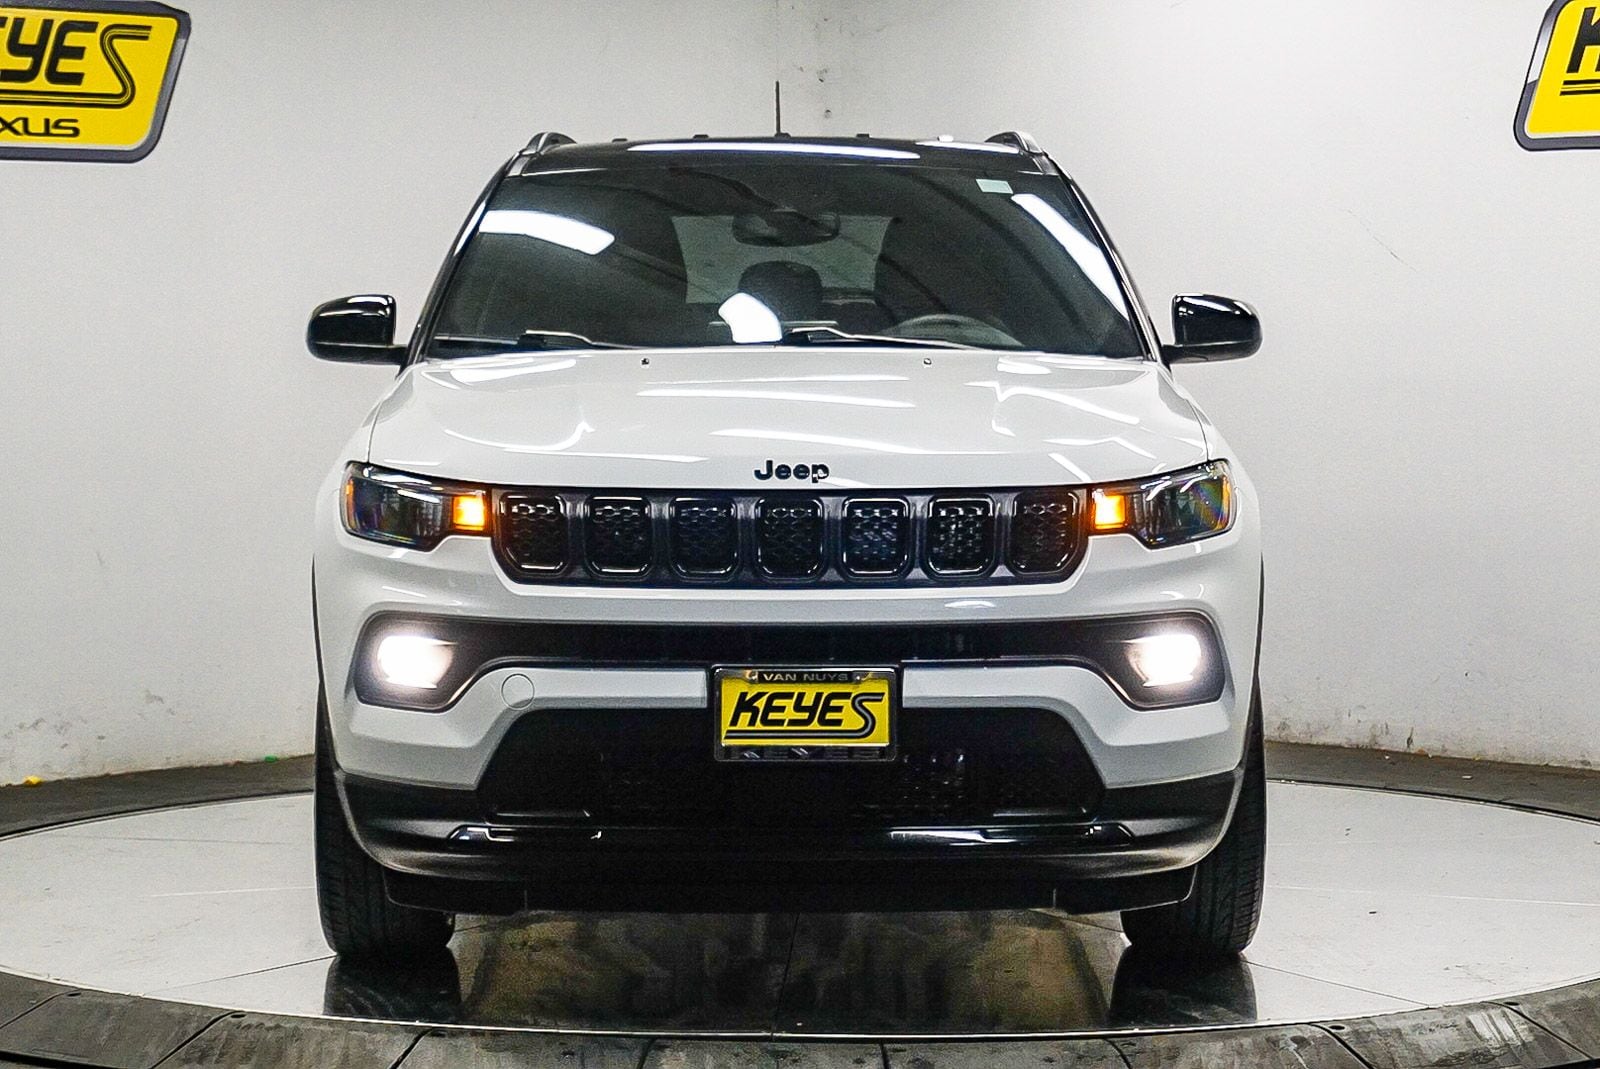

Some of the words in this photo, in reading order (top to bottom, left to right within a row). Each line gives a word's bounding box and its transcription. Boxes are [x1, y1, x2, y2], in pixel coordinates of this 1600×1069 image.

[0, 16, 153, 109] YES
[754, 459, 830, 484] Jeep
[763, 673, 797, 681] VAN
[803, 673, 849, 681] NUYS
[725, 691, 886, 740] KEYES
